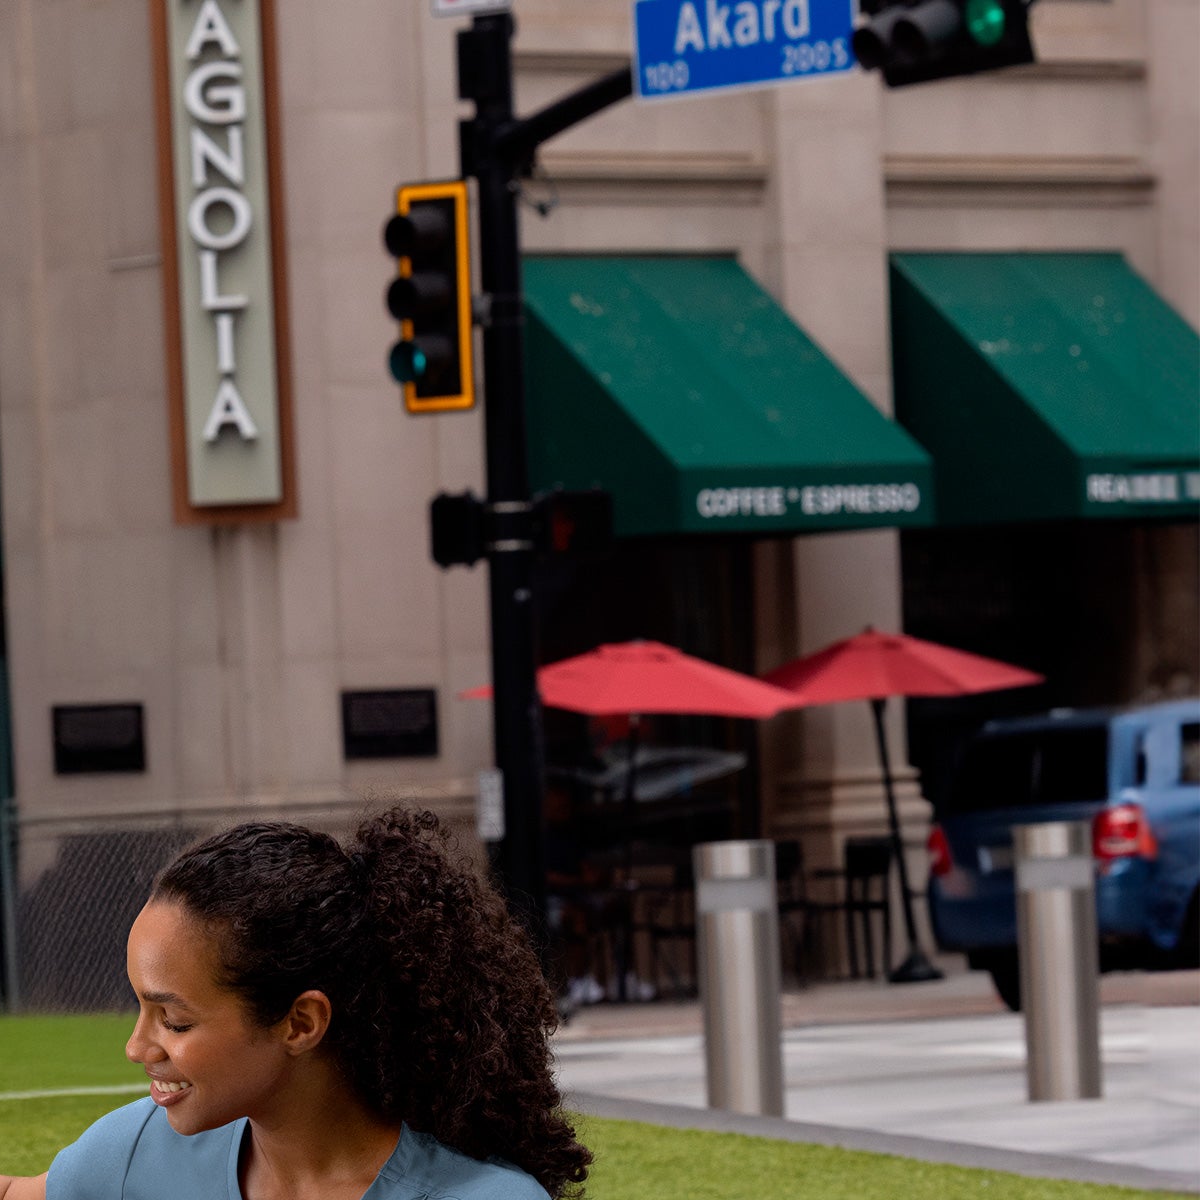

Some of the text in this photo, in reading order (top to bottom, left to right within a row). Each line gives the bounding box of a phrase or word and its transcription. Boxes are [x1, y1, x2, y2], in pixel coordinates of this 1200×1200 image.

[674, 0, 810, 54] Akard
[645, 60, 690, 91] 100
[696, 482, 921, 518] COFFEE ESPRESSO
